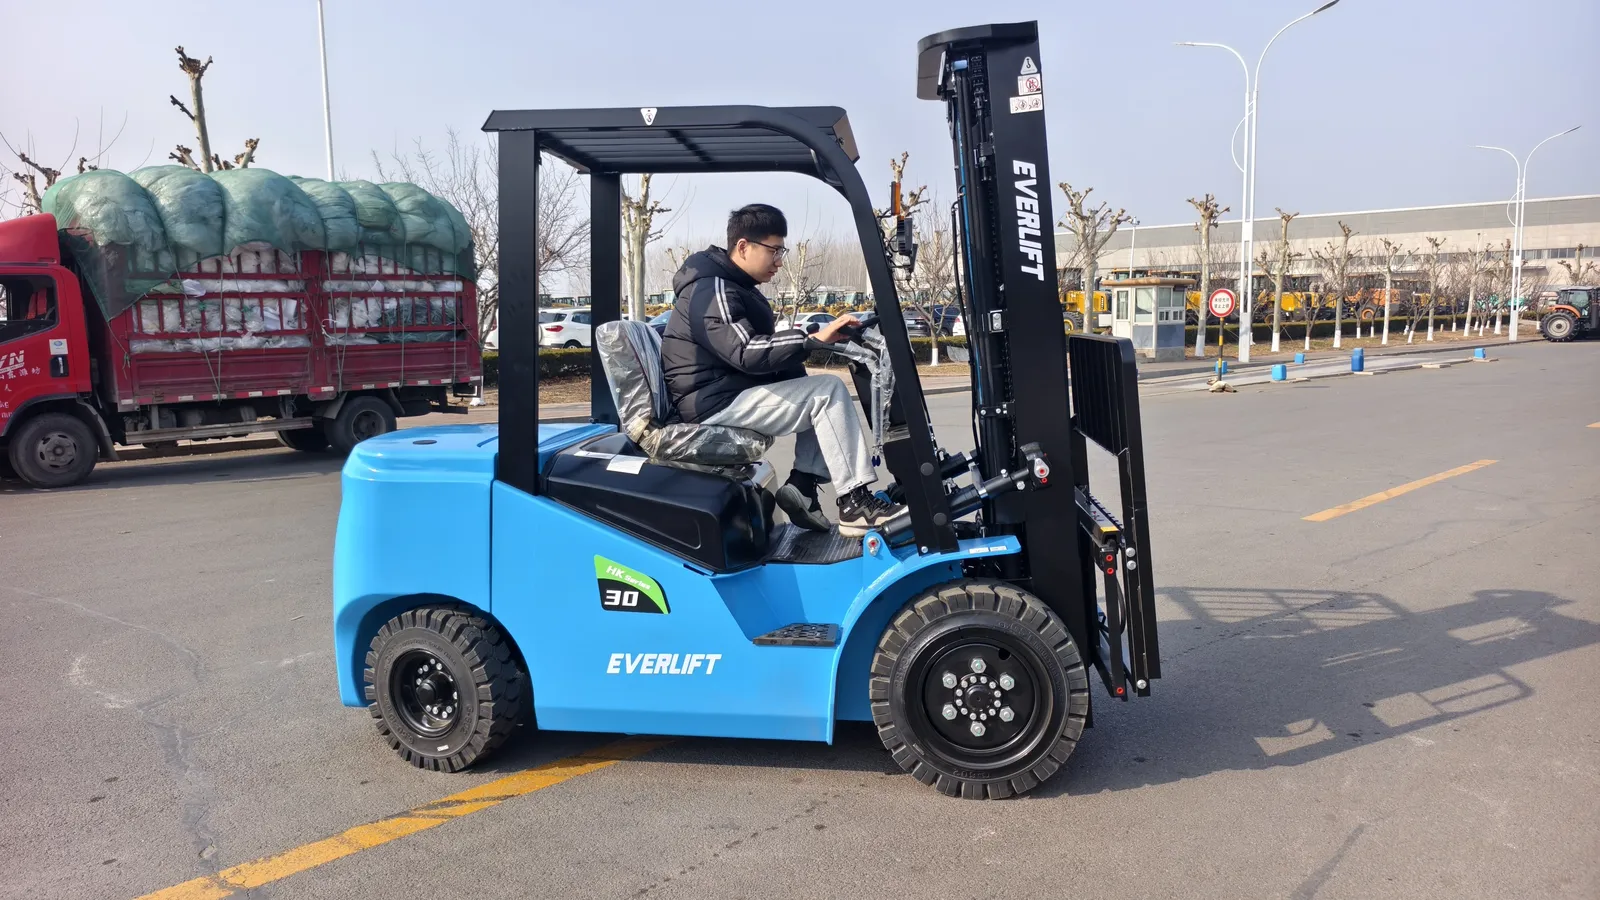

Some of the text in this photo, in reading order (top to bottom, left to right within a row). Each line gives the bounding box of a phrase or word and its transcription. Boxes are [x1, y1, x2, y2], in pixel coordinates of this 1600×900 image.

[1013, 159, 1044, 281] EVERLIFT
[606, 565, 625, 579] HK
[604, 589, 639, 607] 30
[606, 653, 722, 675] EVERLIFT
